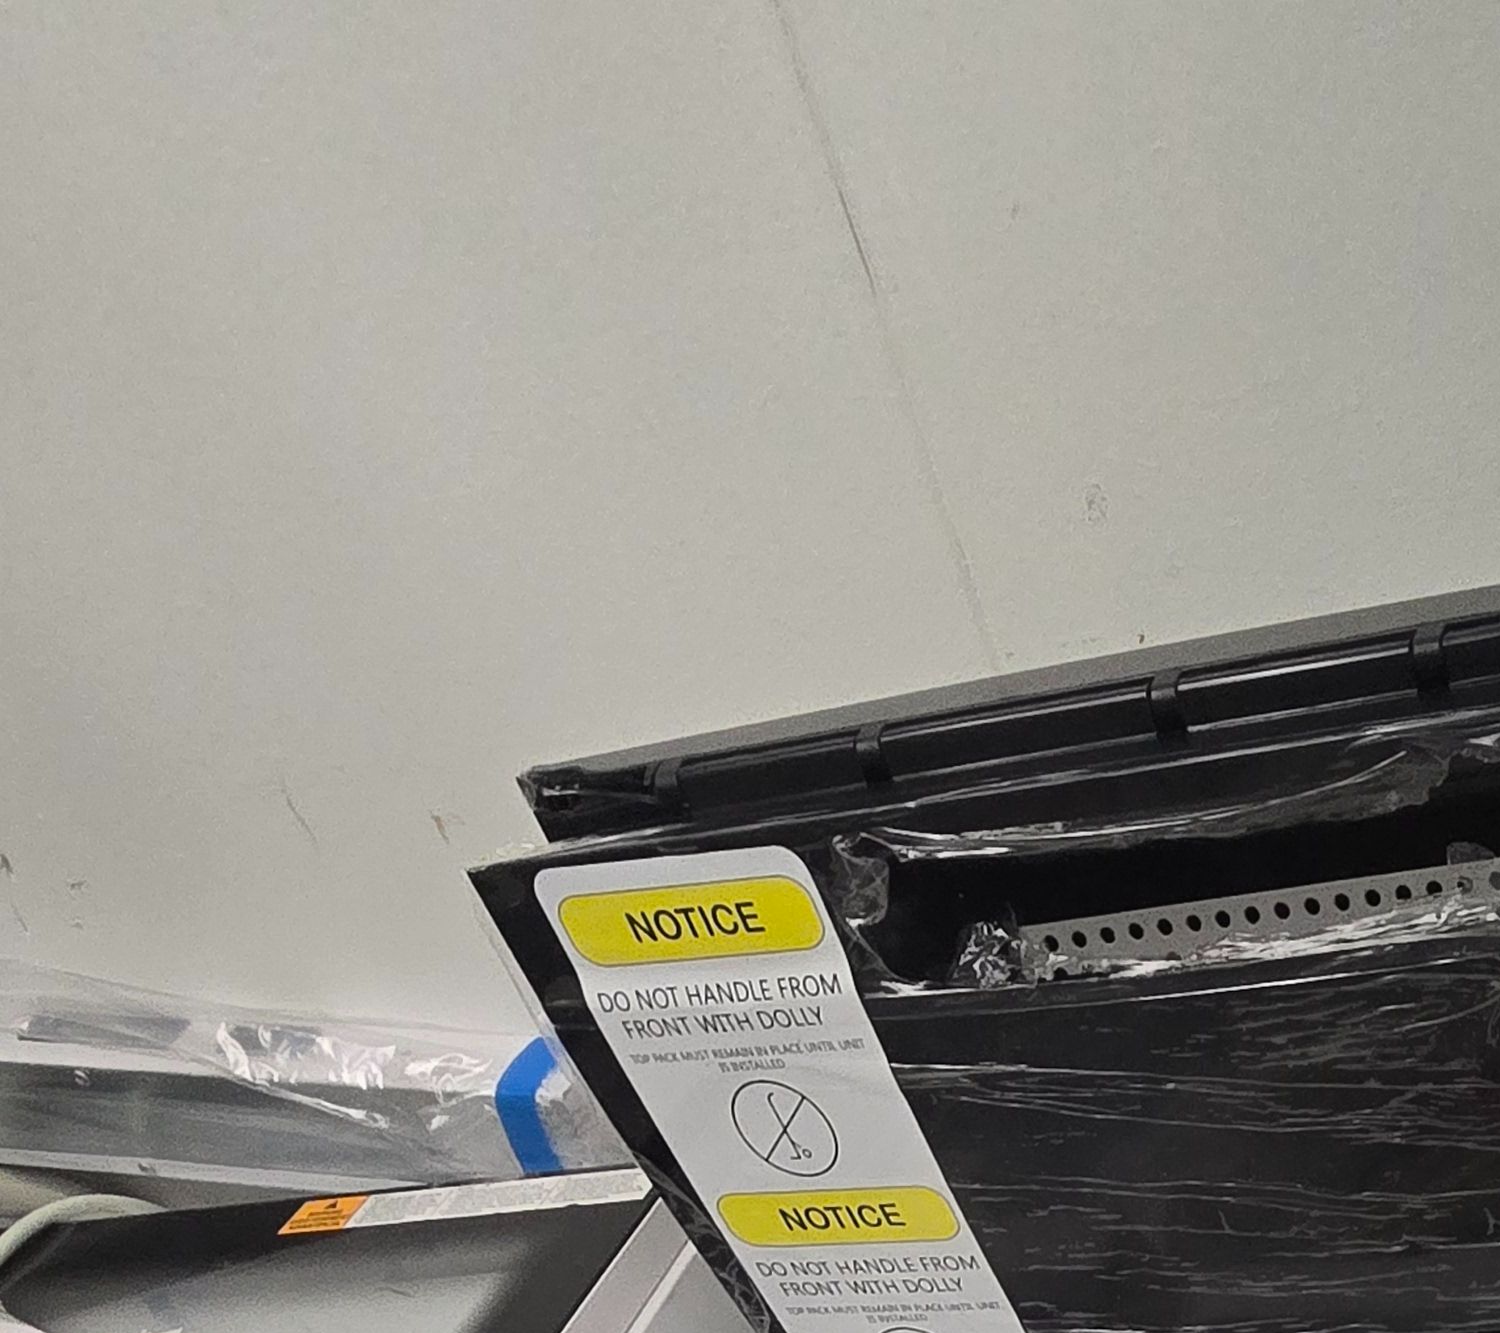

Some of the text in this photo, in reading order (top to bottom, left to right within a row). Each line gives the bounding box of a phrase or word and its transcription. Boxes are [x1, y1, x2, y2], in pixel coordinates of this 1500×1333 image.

[624, 900, 765, 943] NOTICE
[596, 972, 842, 1014] DO NOT HANDLE FROM
[620, 1005, 823, 1039] FRONT WITH DOLLY
[777, 1202, 906, 1231] NOTICE
[754, 1254, 980, 1278] DO NOT HANDLE FROM
[778, 1276, 963, 1297] FRONT WITH DOLLY
